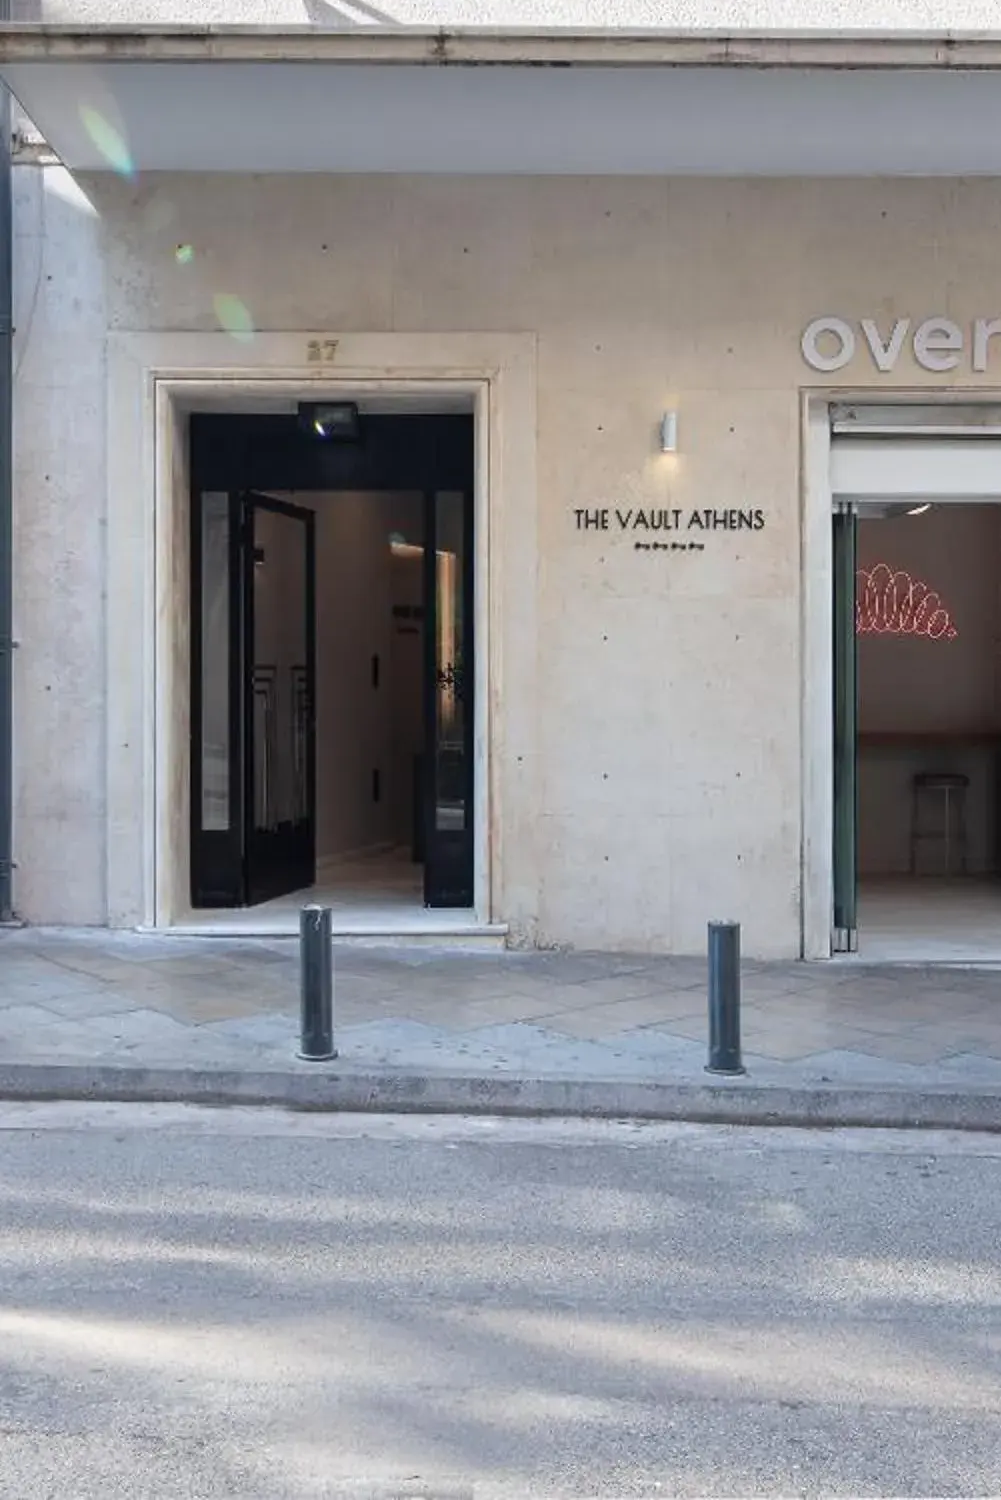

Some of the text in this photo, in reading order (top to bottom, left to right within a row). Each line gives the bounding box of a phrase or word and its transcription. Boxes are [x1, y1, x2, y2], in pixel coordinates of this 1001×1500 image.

[574, 509, 765, 531] THE VAULT ATHENS
